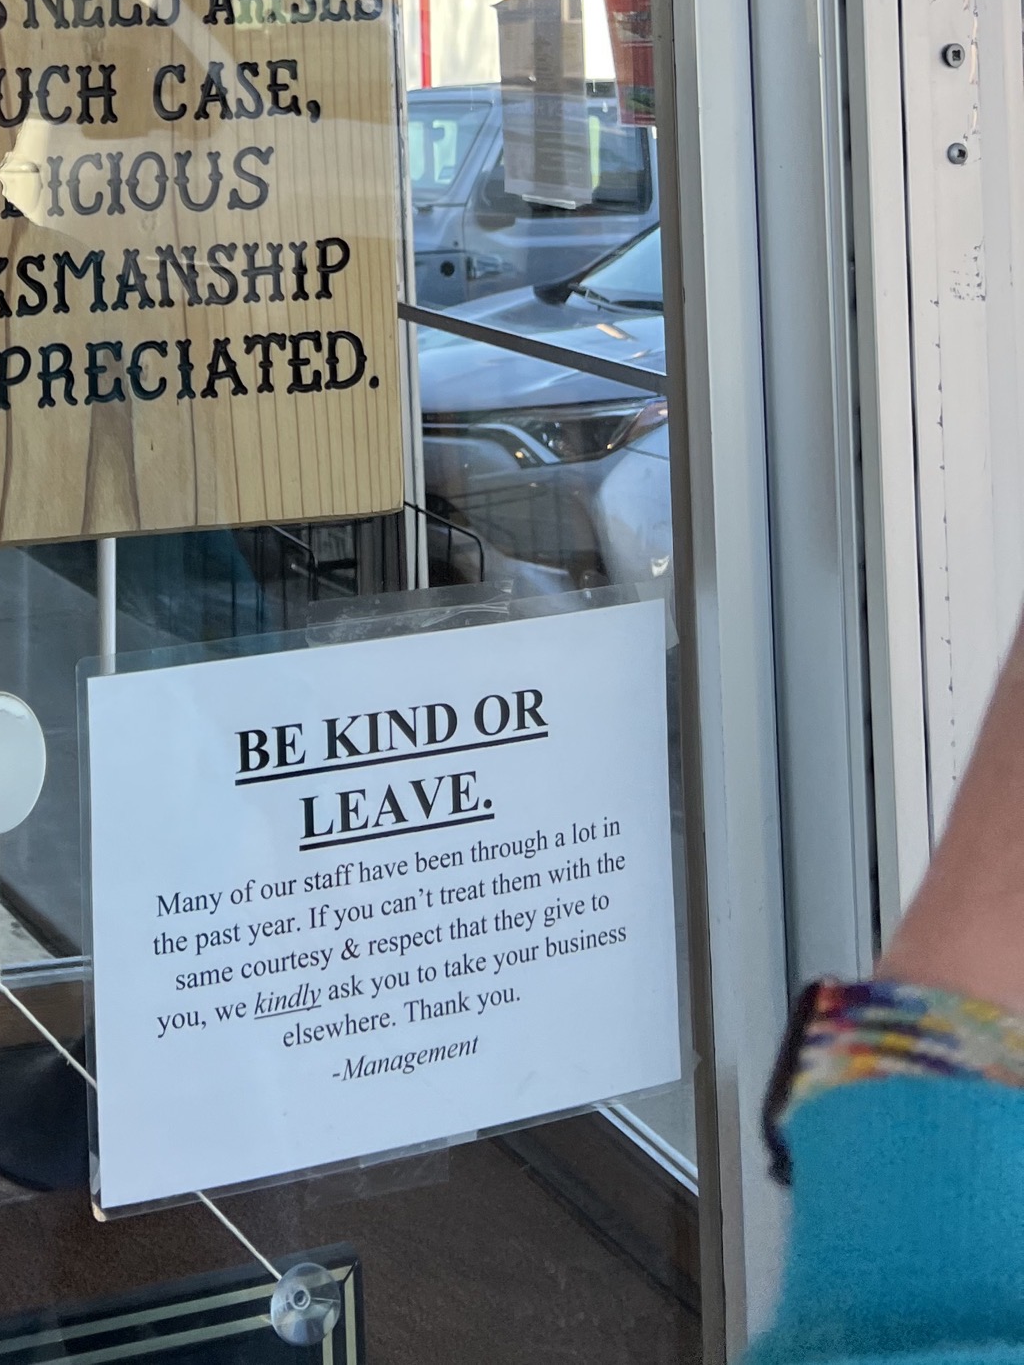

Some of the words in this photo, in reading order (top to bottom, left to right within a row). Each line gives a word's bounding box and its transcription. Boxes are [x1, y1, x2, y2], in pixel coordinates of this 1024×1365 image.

[152, 59, 322, 123] CASE,
[234, 723, 306, 774] BE
[322, 703, 457, 761] KIND
[474, 689, 548, 736] OR
[299, 771, 492, 839] LEAVE.
[153, 932, 187, 955] the
[195, 923, 241, 955] past
[248, 917, 300, 946] year.
[309, 904, 329, 929] If
[334, 904, 374, 931] you
[381, 888, 433, 915] can’t
[440, 880, 485, 905] treat
[492, 873, 541, 895] them
[548, 858, 590, 884] with
[597, 852, 625, 874] the
[156, 892, 222, 917] Many
[230, 879, 256, 904] of
[261, 879, 297, 899] our
[304, 863, 354, 892] staff
[359, 857, 408, 883] have
[415, 848, 463, 872] been
[471, 830, 548, 862] through
[555, 833, 565, 847] a
[572, 823, 597, 844] lot
[604, 817, 620, 837] in
[157, 1011, 206, 1038] you,
[215, 1002, 246, 1021] we
[254, 983, 321, 1020] kindly
[329, 975, 364, 1000] ask
[371, 971, 410, 999] you
[417, 965, 436, 983] to
[444, 953, 486, 978] take
[493, 945, 539, 975] your
[545, 927, 626, 957] business
[176, 967, 233, 990] same
[241, 948, 333, 979] courtesy
[341, 938, 360, 960] &
[368, 924, 442, 956] respect
[449, 916, 487, 940] that
[494, 907, 536, 936] they
[544, 898, 585, 927] give
[592, 894, 609, 911] to
[283, 1013, 396, 1047] elsewhere.
[404, 991, 470, 1022] Thank
[477, 988, 520, 1015] you.
[333, 1036, 478, 1081] -Management
